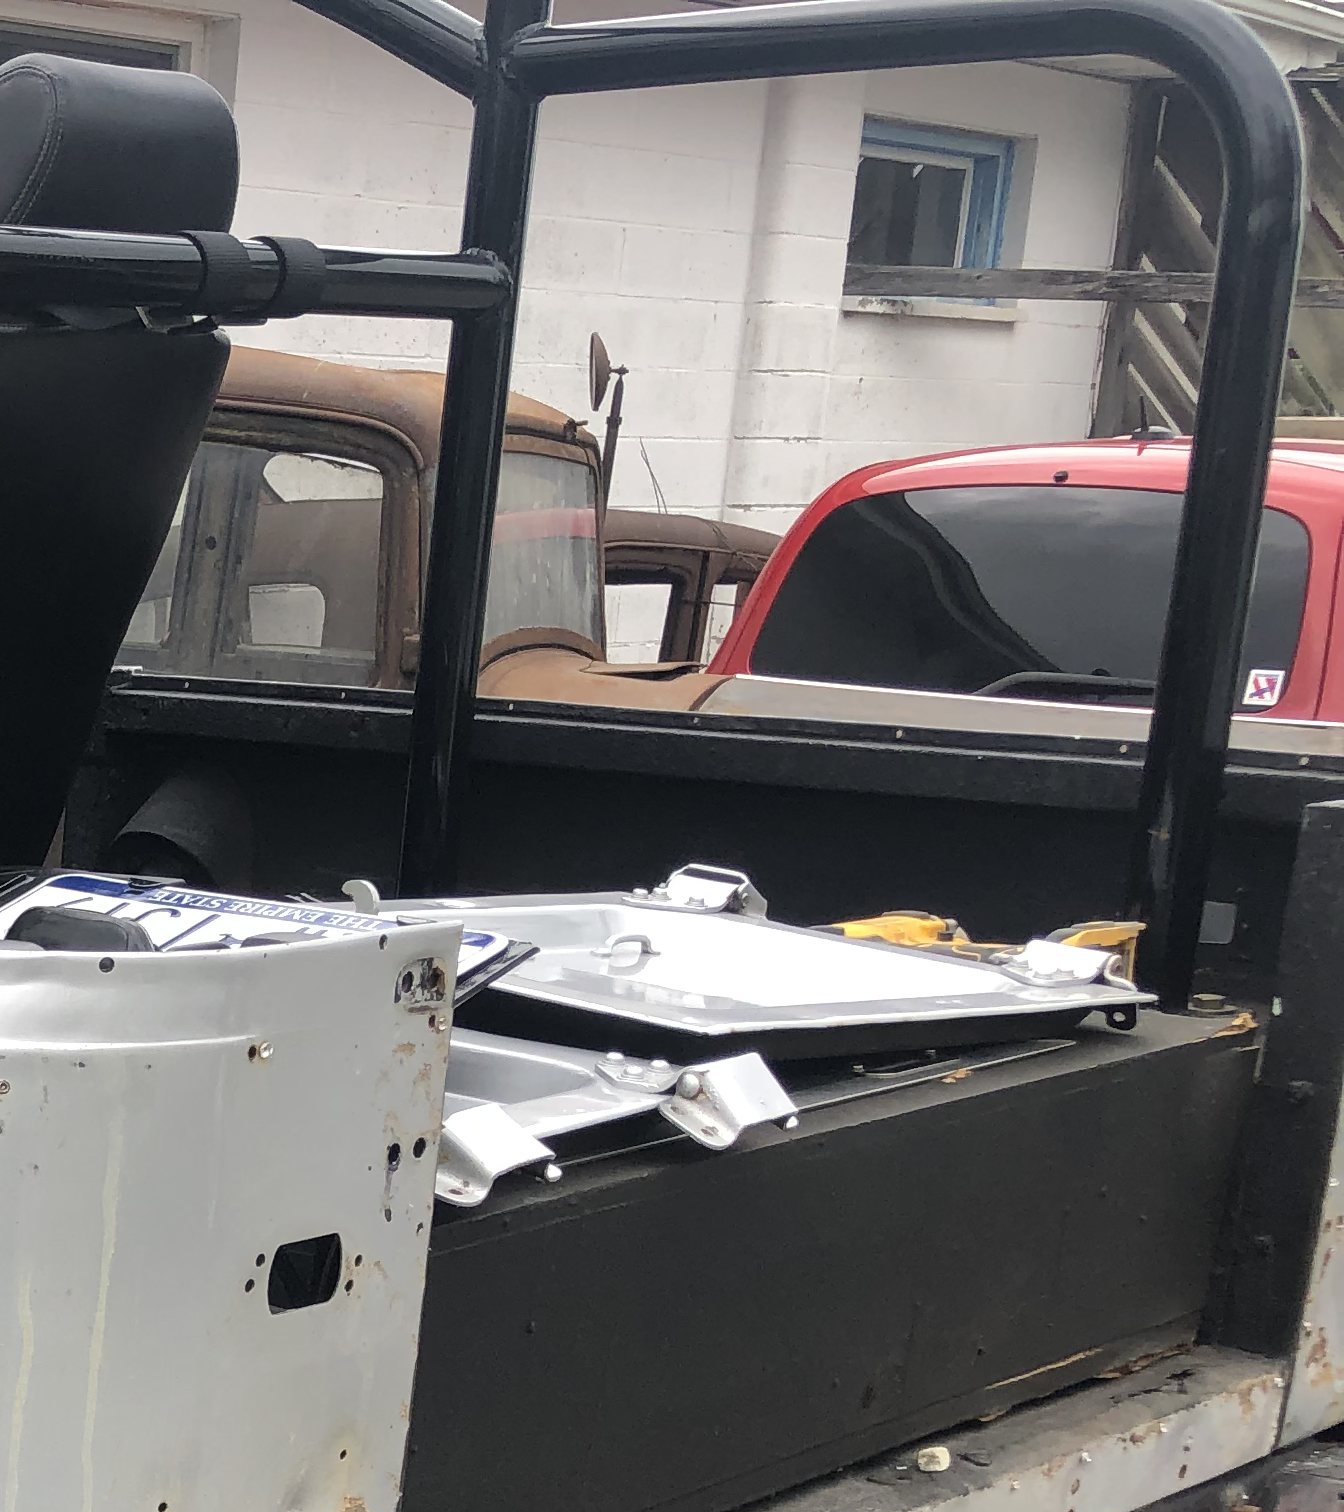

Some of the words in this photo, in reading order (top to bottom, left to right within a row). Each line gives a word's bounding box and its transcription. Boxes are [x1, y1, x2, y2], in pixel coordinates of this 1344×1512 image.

[149, 890, 228, 910] STATE
[223, 900, 321, 924] EMPIRE
[322, 913, 383, 931] THE
